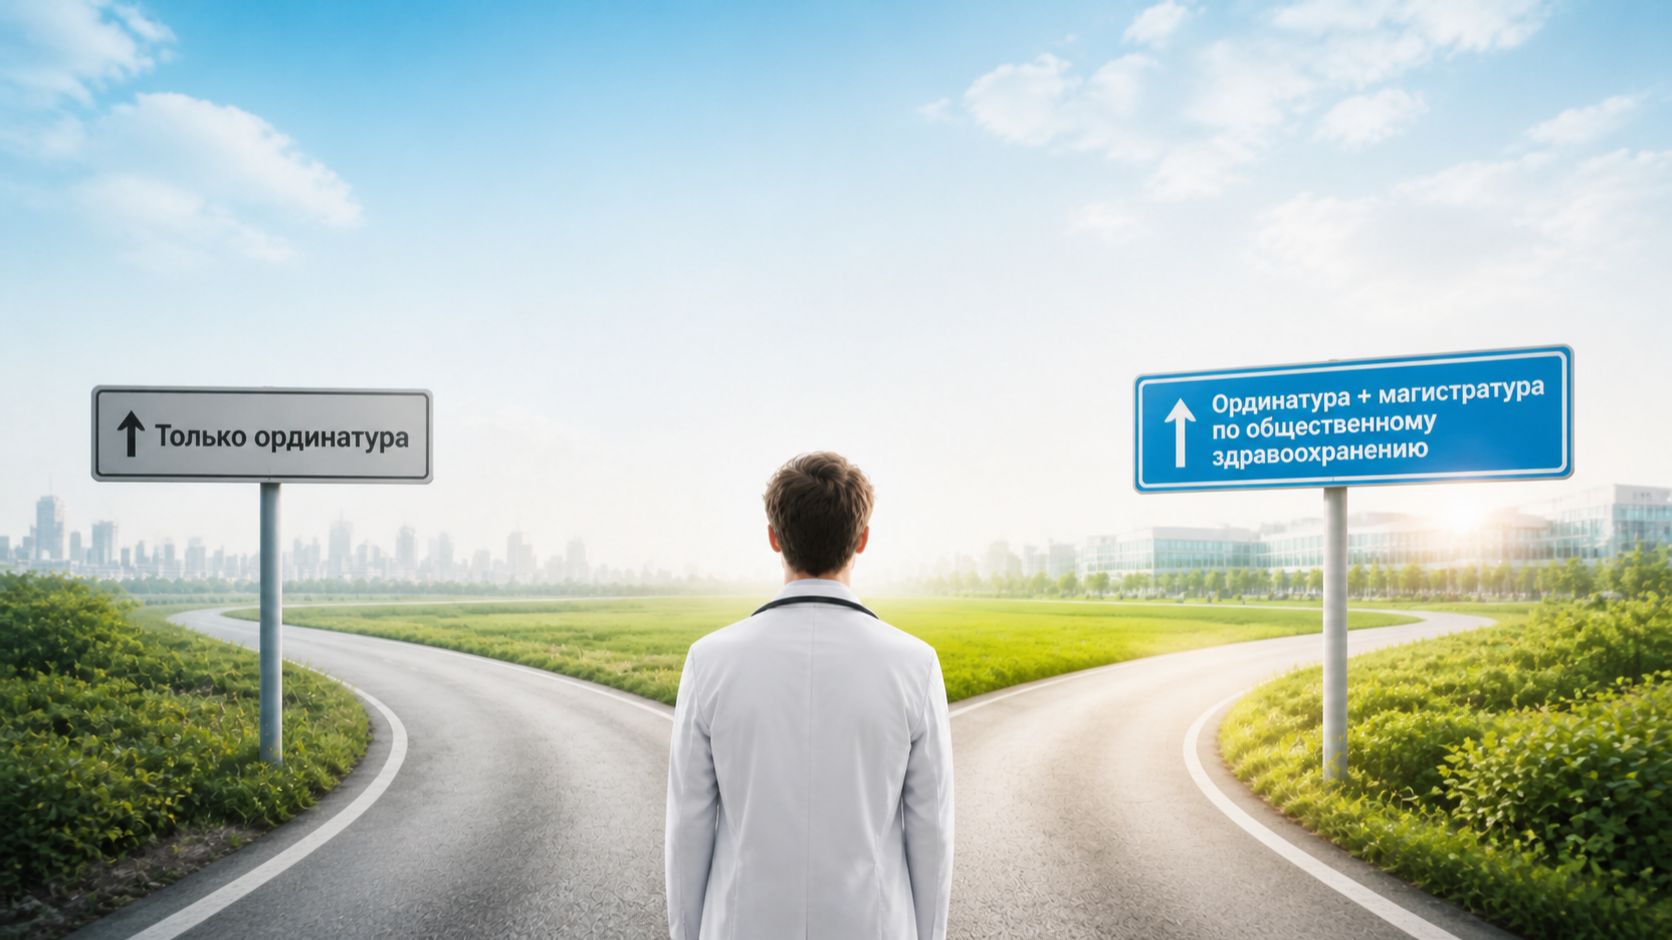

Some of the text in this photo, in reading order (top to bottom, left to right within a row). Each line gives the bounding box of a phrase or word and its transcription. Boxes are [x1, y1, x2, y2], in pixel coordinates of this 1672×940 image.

[1212, 379, 1545, 417] Ординатура + магистратура
[155, 424, 409, 453] Только ординатура
[1213, 412, 1437, 440] по общественному
[1212, 441, 1429, 470] здравоохранению
